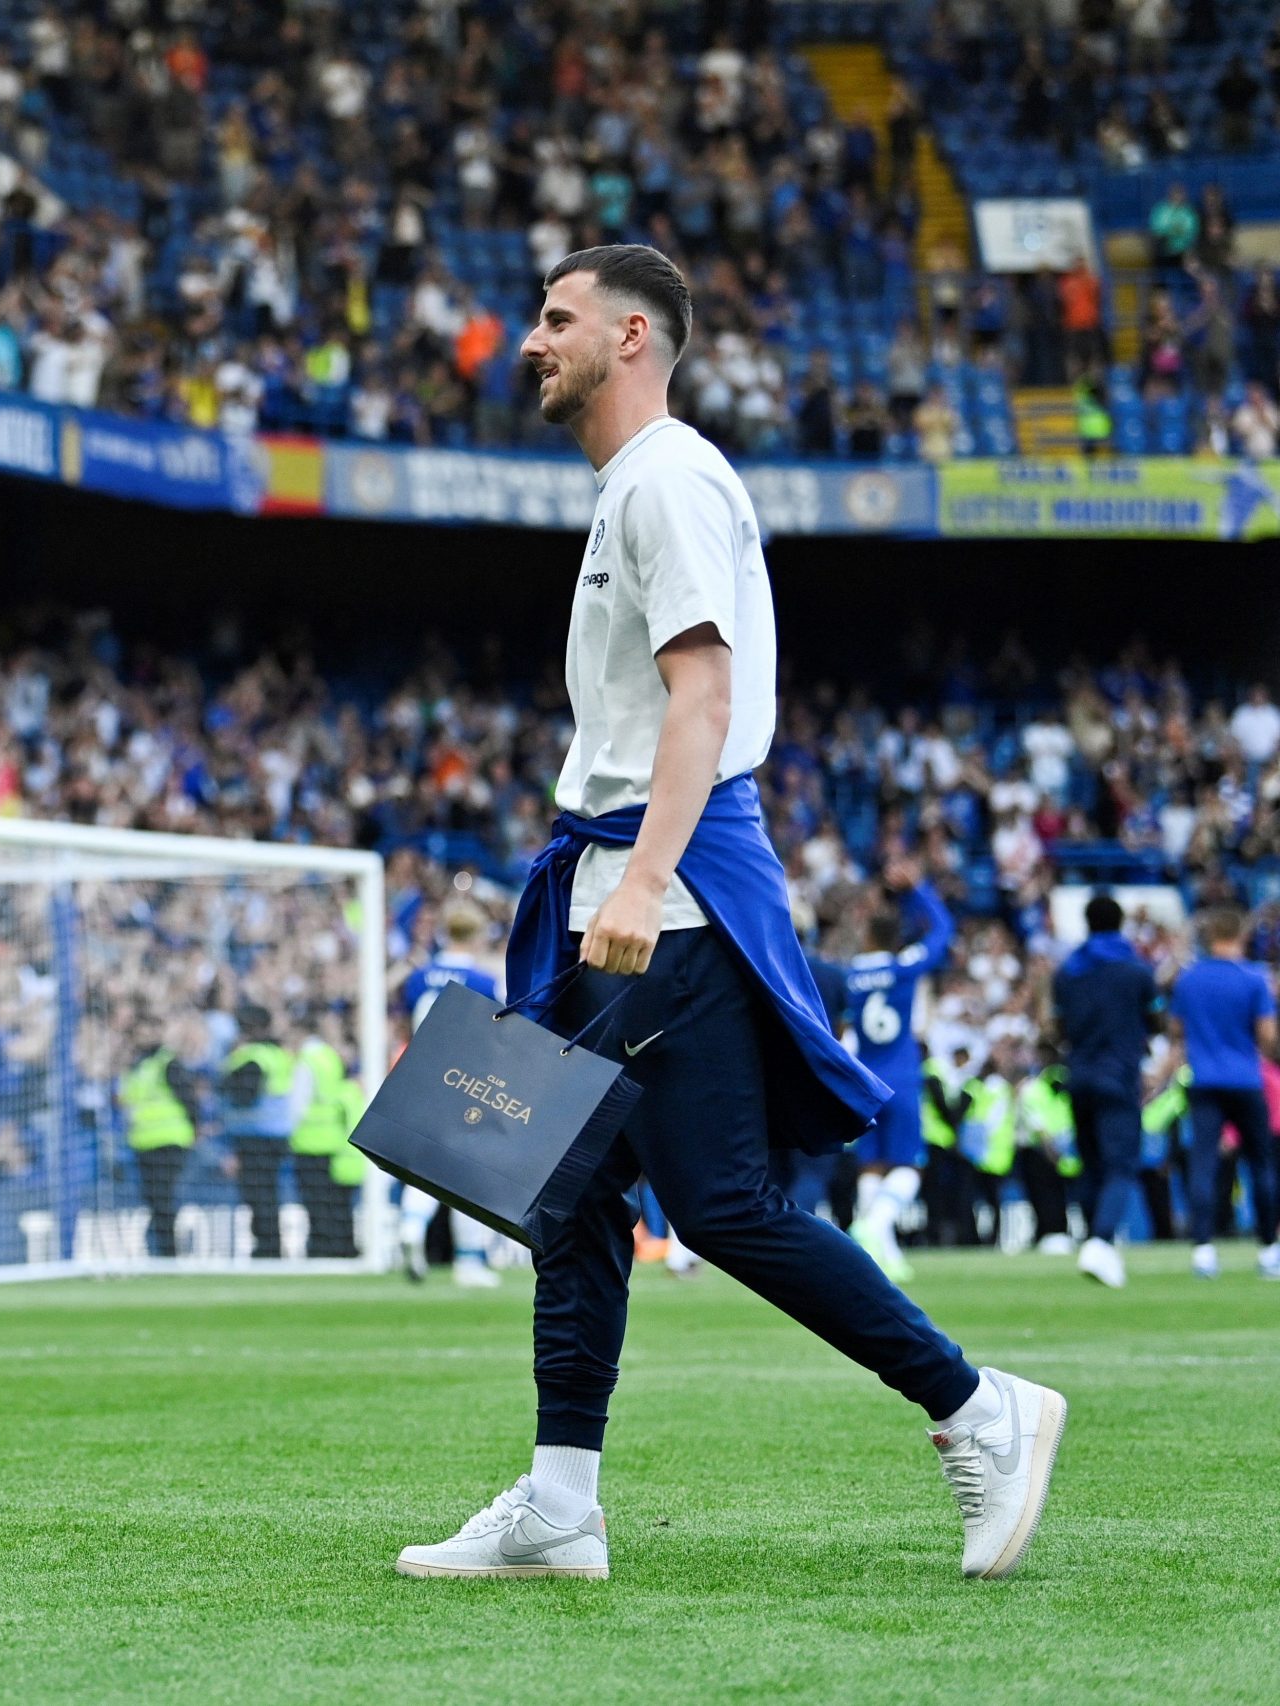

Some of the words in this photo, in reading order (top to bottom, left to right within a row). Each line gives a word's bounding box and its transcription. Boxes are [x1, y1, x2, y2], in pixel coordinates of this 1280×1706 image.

[862, 990, 902, 1046] 6
[443, 1068, 531, 1125] CHELSEA
[486, 1074, 507, 1088] CLUB
